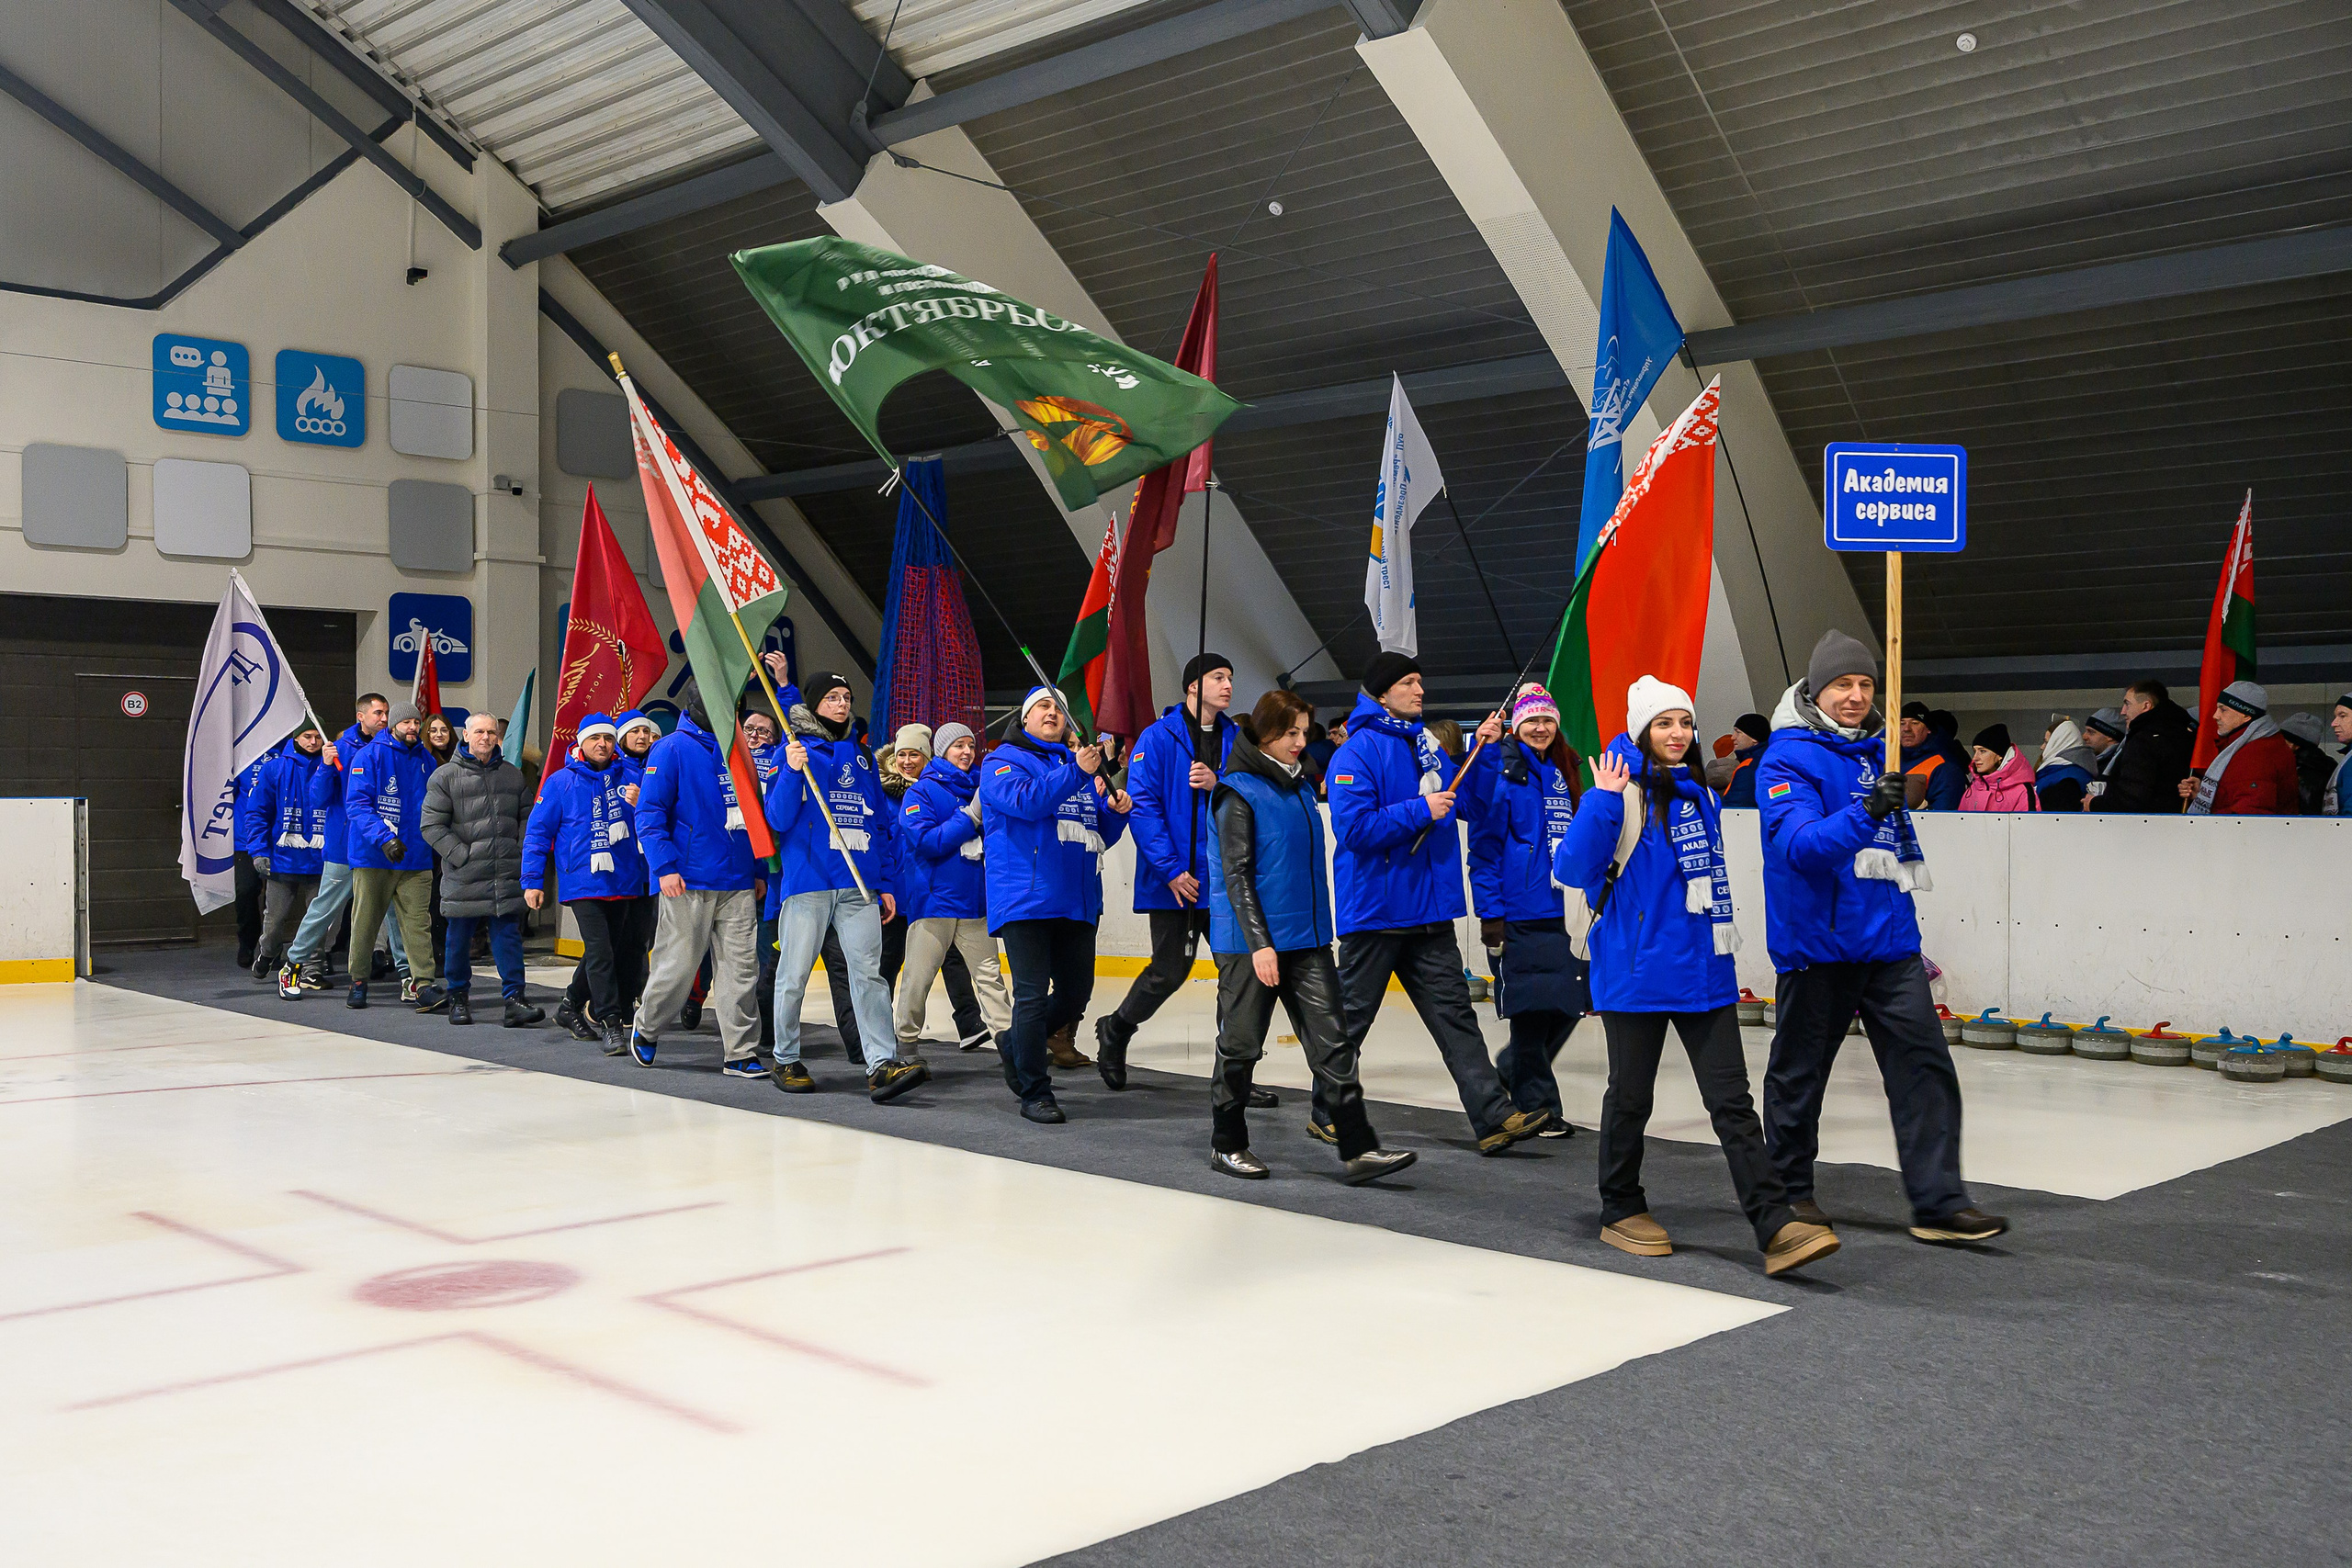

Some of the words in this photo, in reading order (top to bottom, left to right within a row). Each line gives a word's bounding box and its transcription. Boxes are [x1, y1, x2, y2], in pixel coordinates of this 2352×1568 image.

[1843, 468, 1949, 494] Академия
[1855, 501, 1937, 527] сервиса
[127, 700, 141, 709] B2
[835, 804, 859, 812] СЕРВИСА
